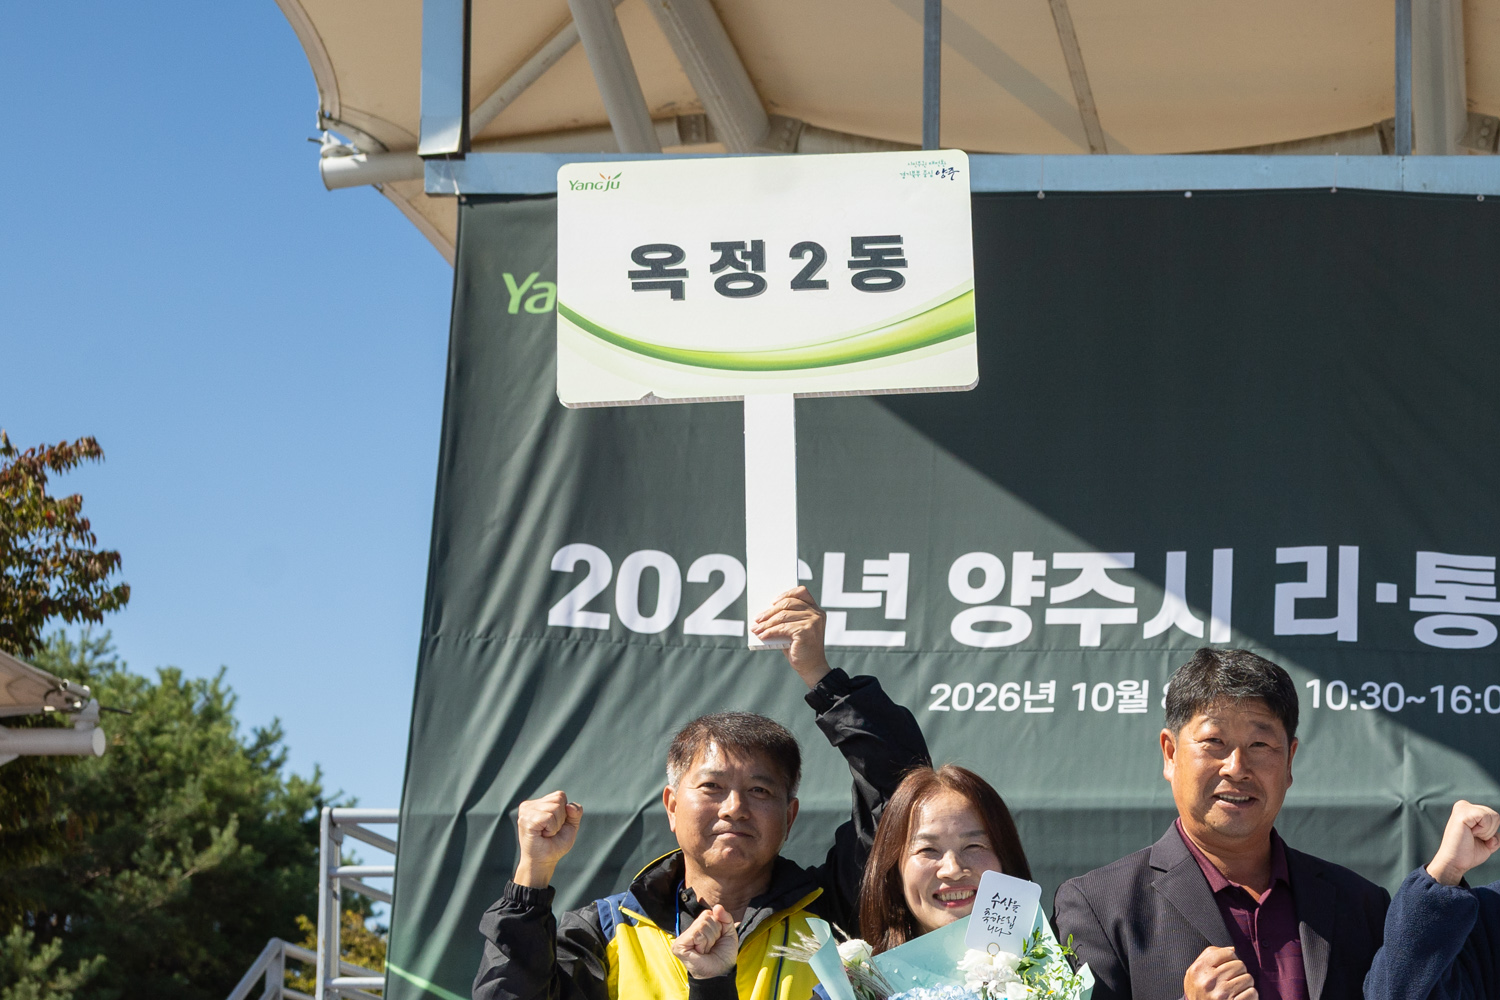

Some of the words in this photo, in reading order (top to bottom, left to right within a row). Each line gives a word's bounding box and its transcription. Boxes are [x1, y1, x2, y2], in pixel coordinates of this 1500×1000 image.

[548, 542, 910, 647] 202년
[947, 548, 1233, 648] 양주시
[928, 680, 1056, 713] 2026년
[1072, 680, 1149, 713] 10월
